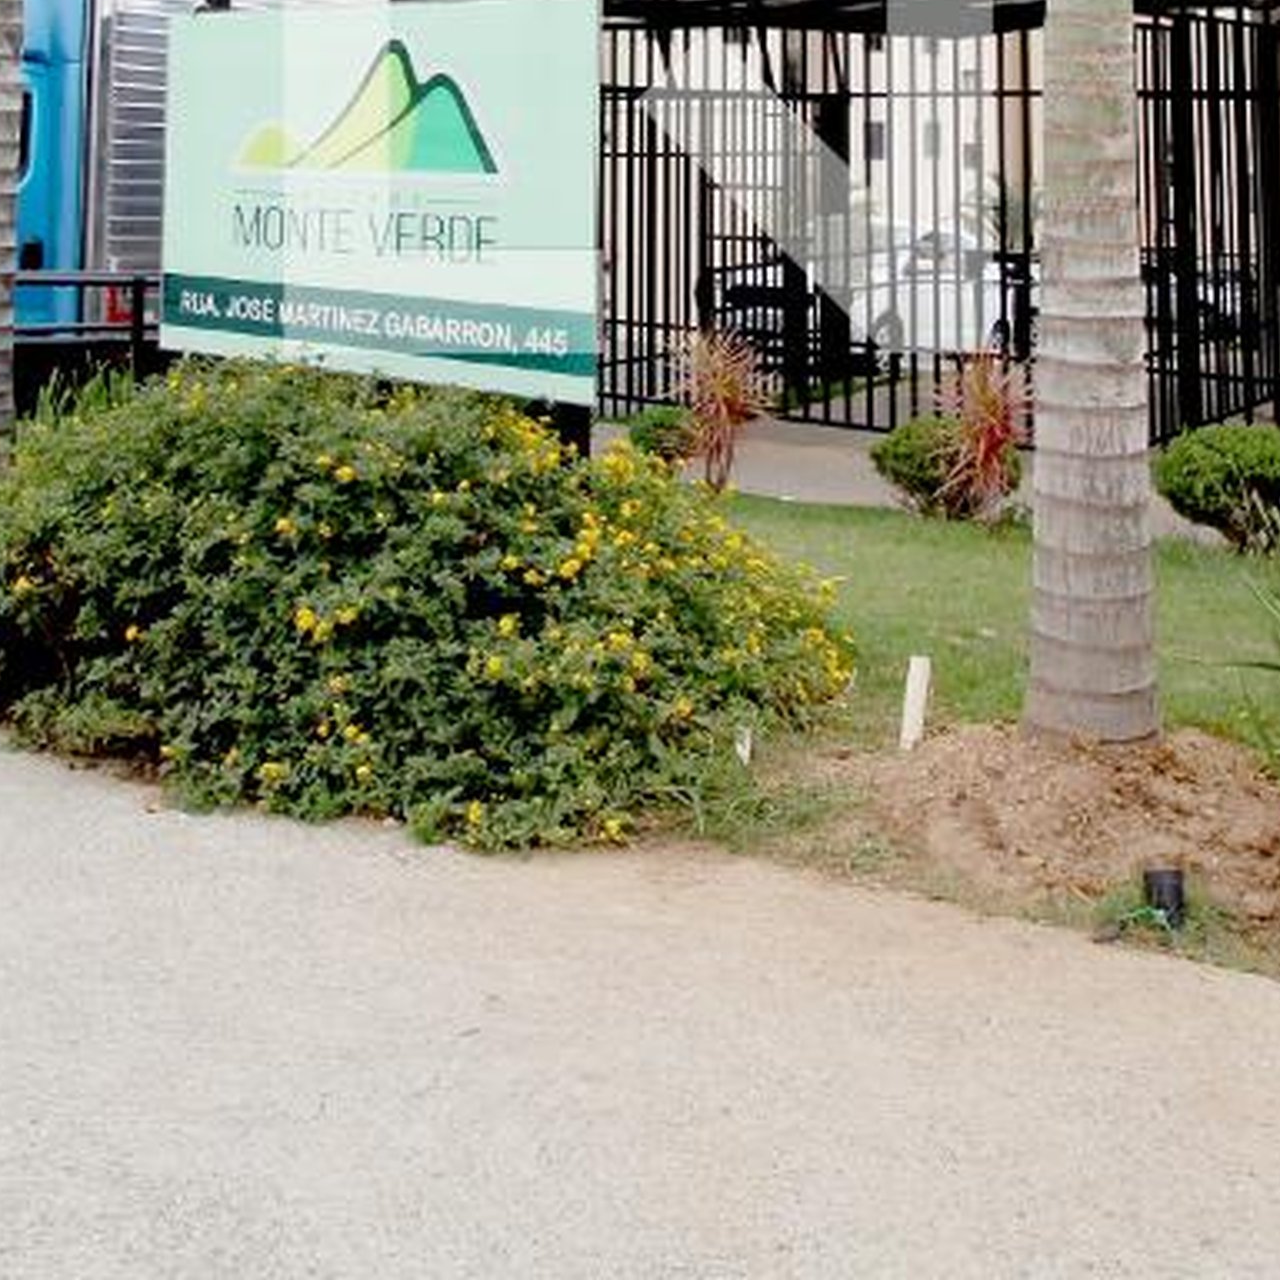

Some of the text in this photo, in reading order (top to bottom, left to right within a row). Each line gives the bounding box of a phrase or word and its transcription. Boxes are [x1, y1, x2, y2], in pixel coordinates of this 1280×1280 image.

[233, 204, 499, 265] MONTE VERDE
[277, 301, 380, 336] MARTINEZ
[384, 311, 518, 354] GABARRON,
[523, 326, 569, 358] 445
